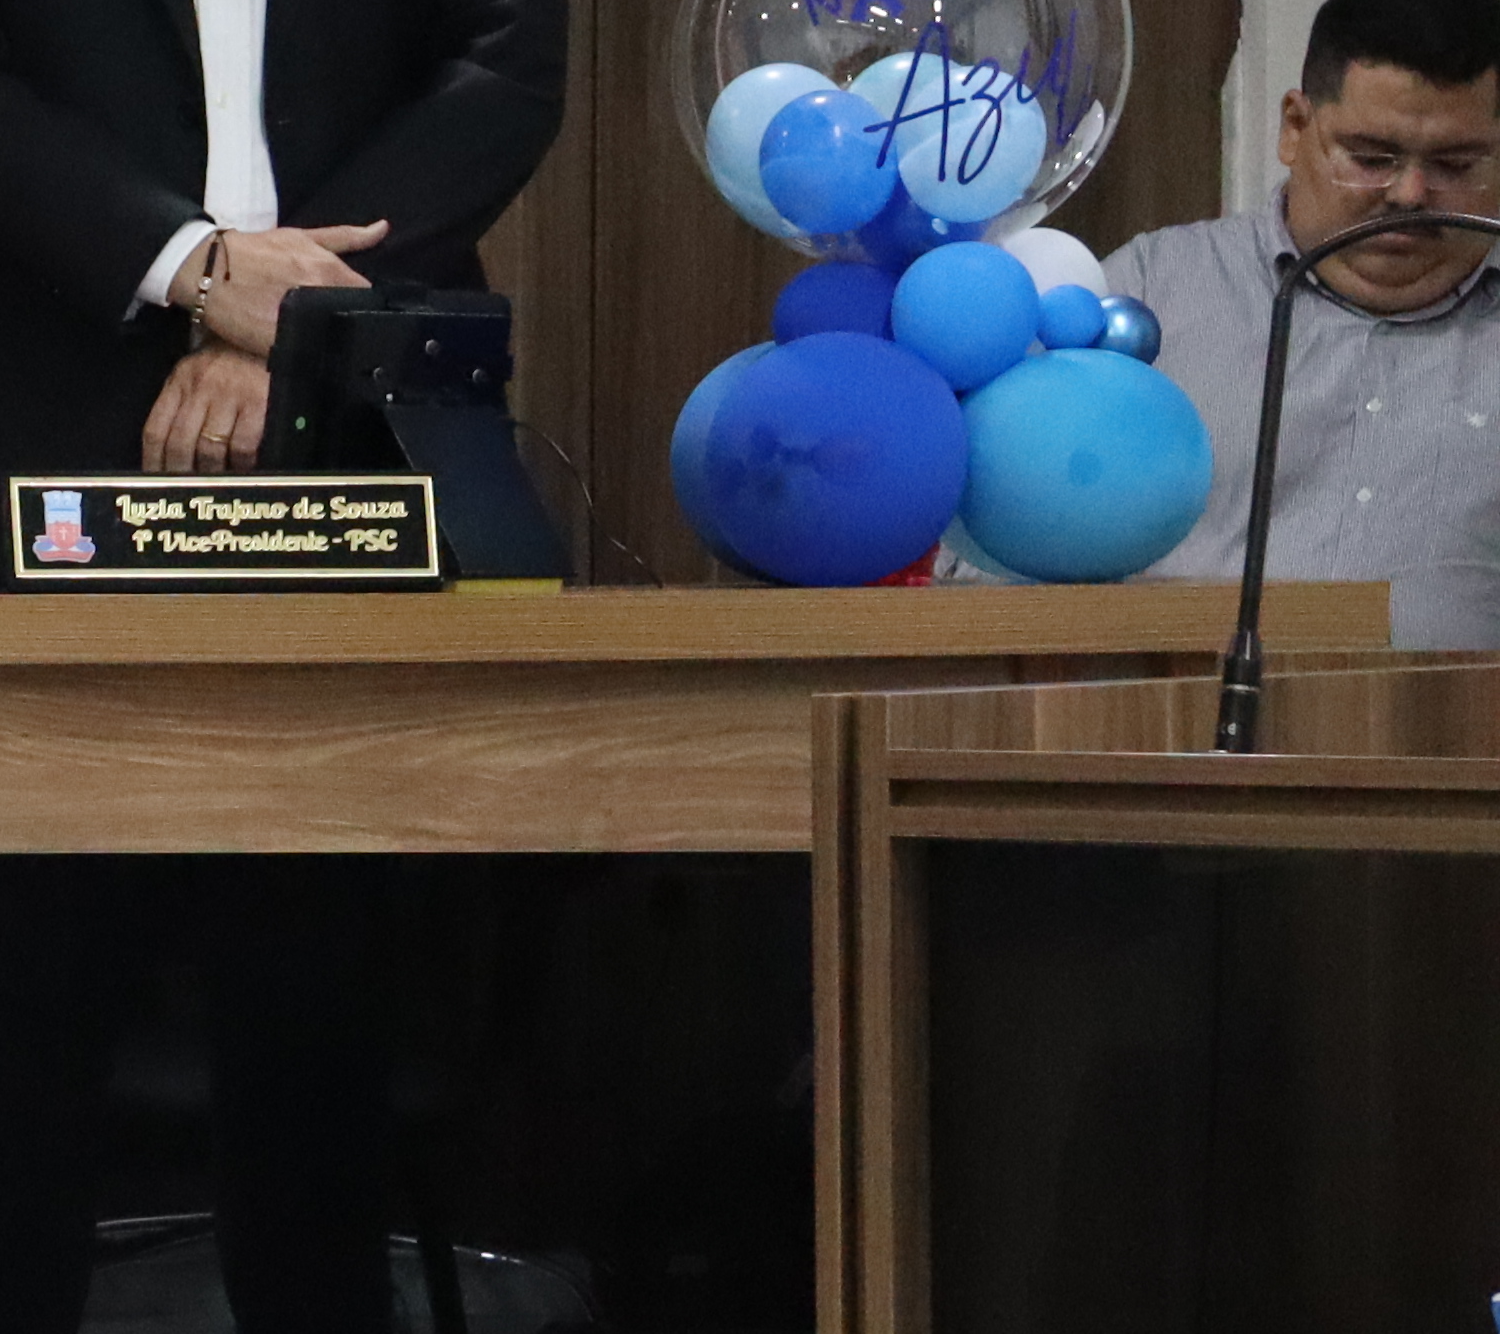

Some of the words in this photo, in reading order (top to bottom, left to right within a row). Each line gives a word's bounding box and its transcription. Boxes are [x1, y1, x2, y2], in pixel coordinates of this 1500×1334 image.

[116, 494, 187, 527] Luzia
[189, 496, 290, 527] Trajano
[292, 496, 326, 521] de
[329, 495, 409, 521] Souza
[343, 528, 398, 552] PSC
